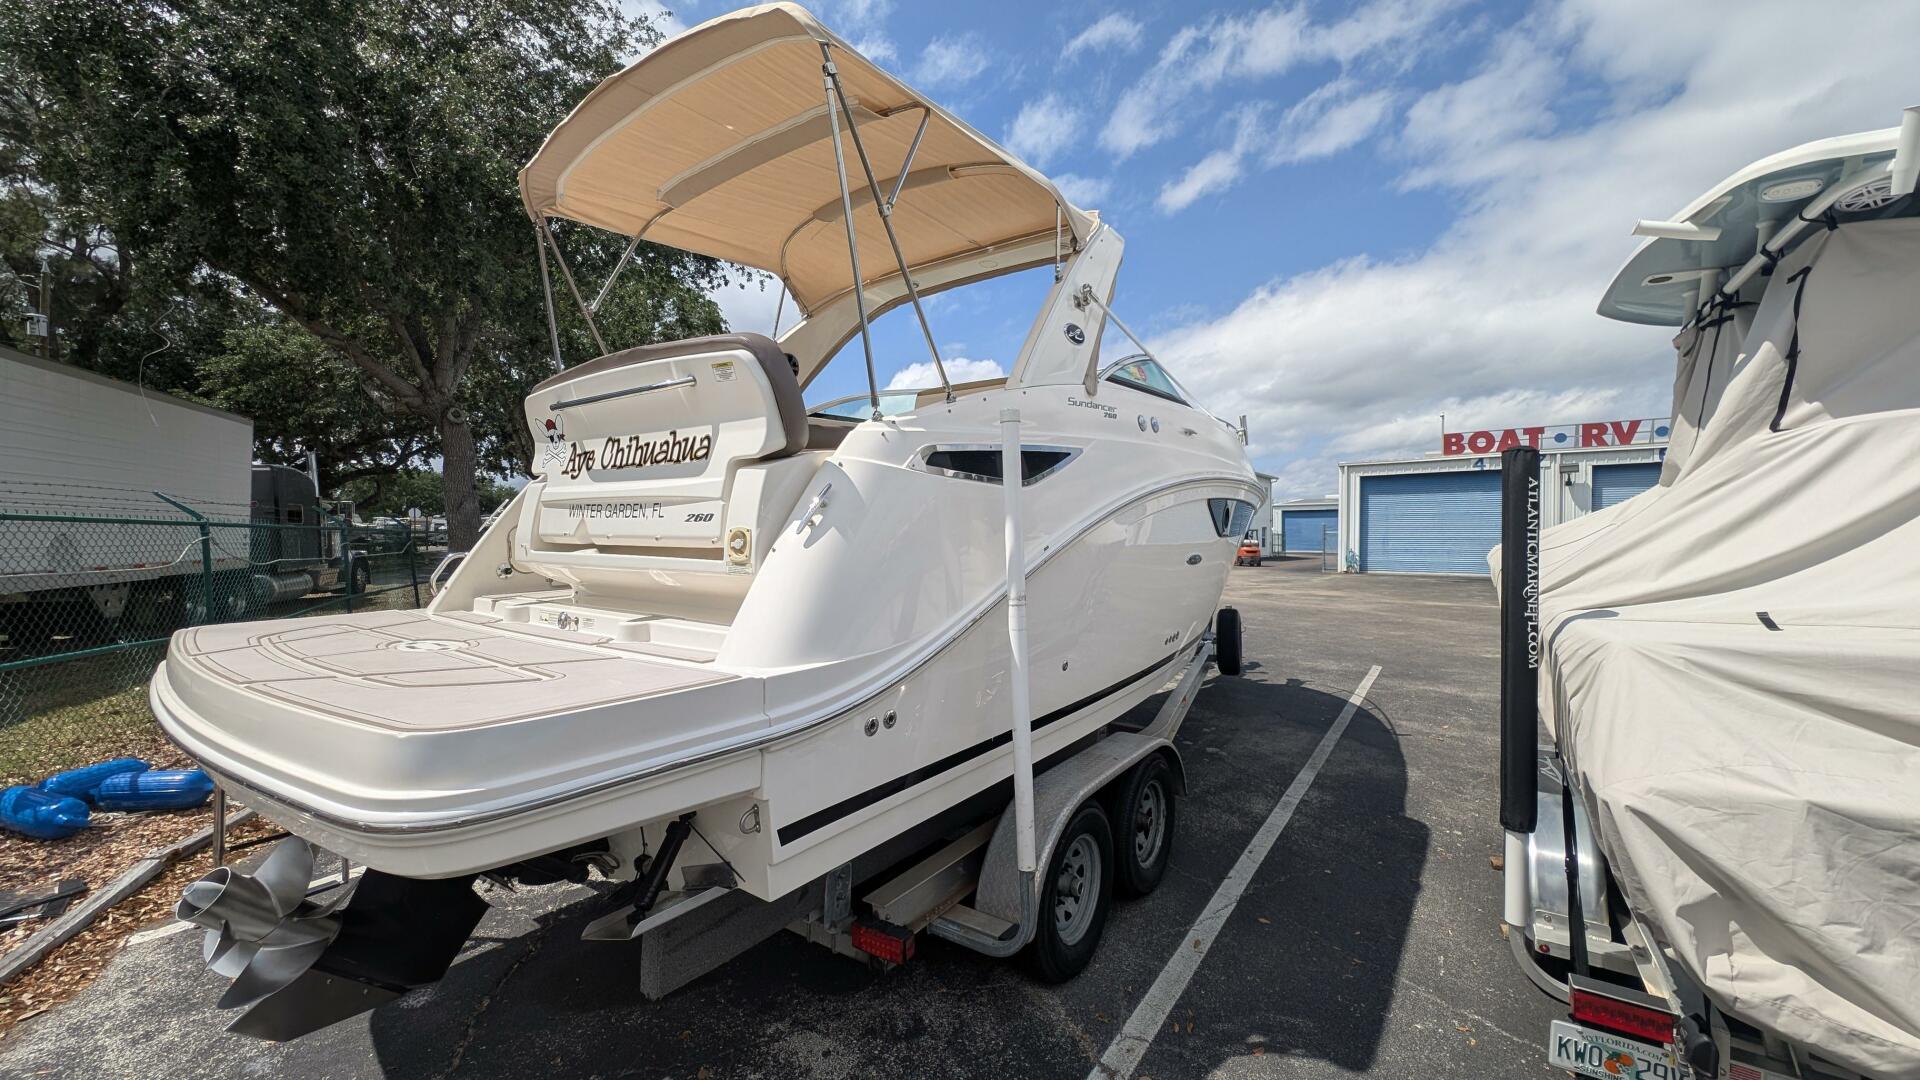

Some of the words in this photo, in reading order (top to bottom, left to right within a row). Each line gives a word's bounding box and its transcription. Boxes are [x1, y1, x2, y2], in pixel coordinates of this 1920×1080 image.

[1067, 397, 1117, 412] Sundancer
[1443, 426, 1545, 456] BOAT
[1582, 420, 1642, 447] RV
[561, 442, 596, 479] Aye
[601, 431, 711, 469] Chihuahua
[1473, 457, 1486, 471] 4
[568, 503, 603, 519] WINTER
[604, 502, 649, 520] GARDEN,
[651, 501, 664, 518] FL
[684, 512, 715, 523] 260
[1580, 1034, 1663, 1062] MYFLORIDA.COM
